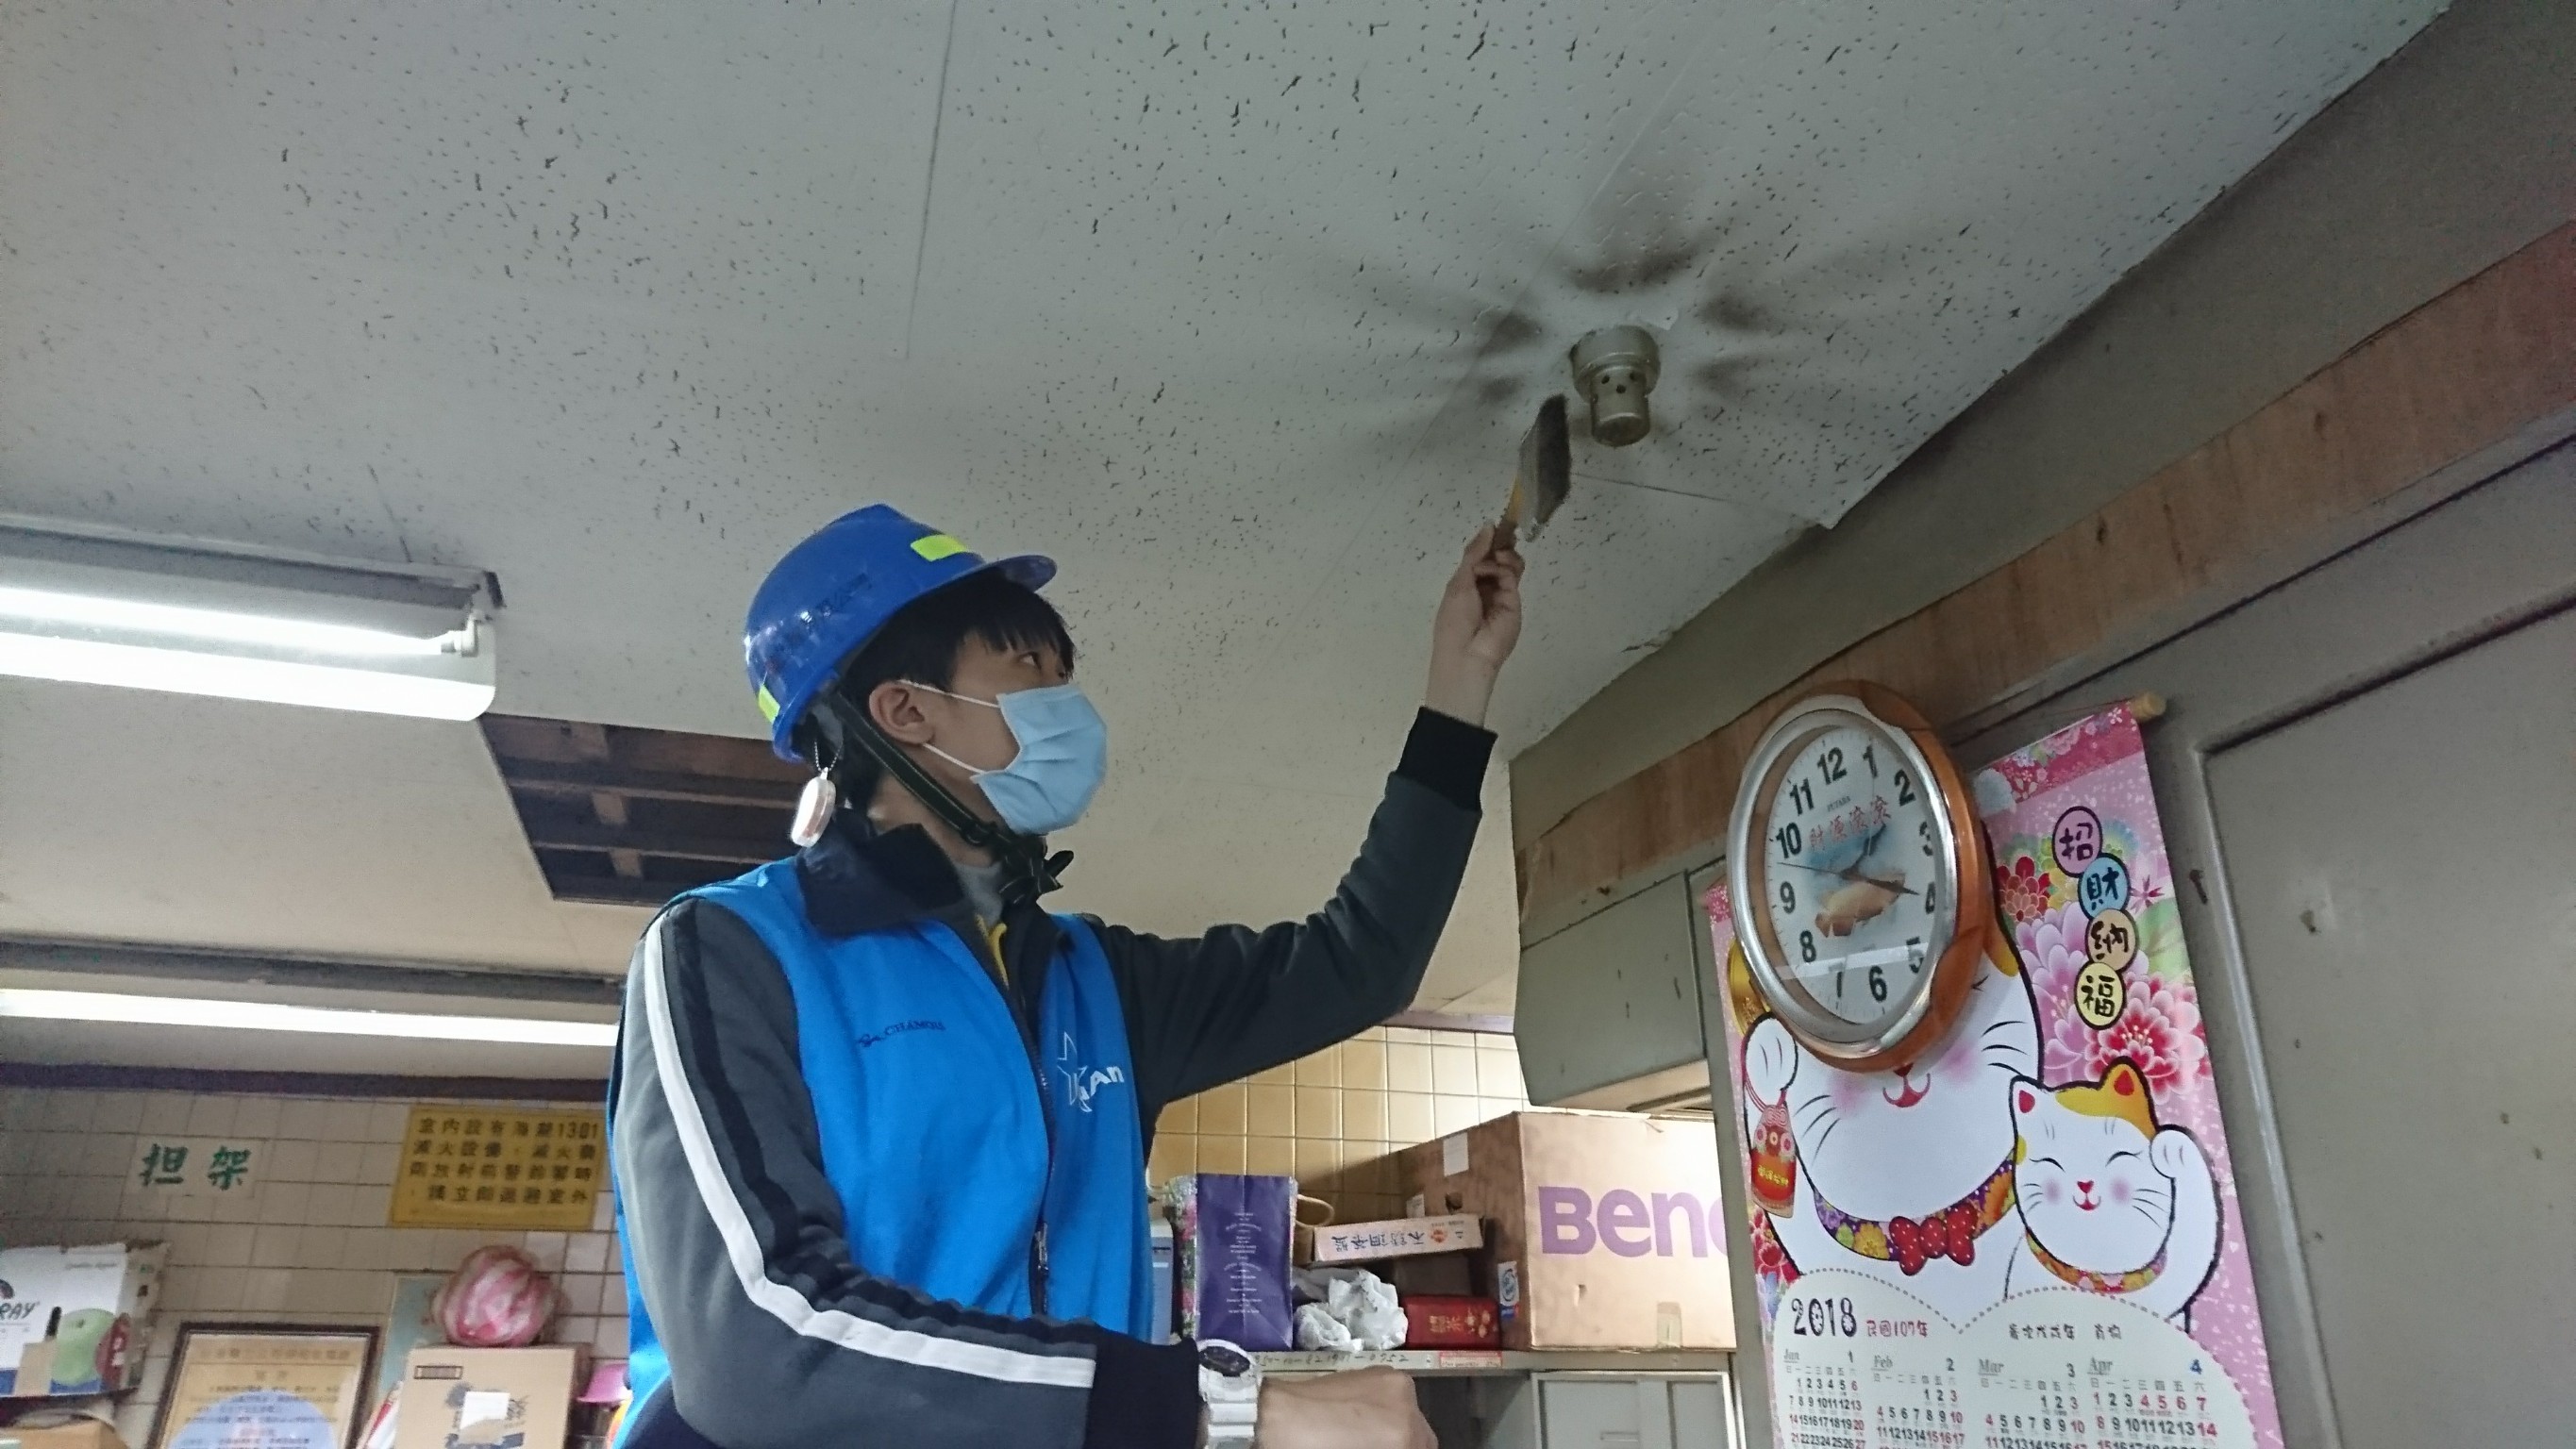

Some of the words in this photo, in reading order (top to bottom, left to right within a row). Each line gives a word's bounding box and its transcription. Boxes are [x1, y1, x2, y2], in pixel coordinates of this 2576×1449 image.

[1816, 746, 1848, 785] 12
[1863, 744, 1878, 779] 1
[1789, 777, 1815, 816] 11
[1894, 769, 1916, 807] 2
[1775, 822, 1802, 858] 10
[1919, 821, 1933, 857] 3
[1780, 881, 1796, 914] 9
[1925, 881, 1936, 914] 4
[2059, 823, 2129, 1018] 招財納福
[1799, 929, 1816, 963] 8
[1906, 936, 1924, 974] 5
[1868, 965, 1887, 1002] 6
[139, 1142, 252, 1191] 担架
[1792, 1297, 1857, 1337] 2018
[1784, 1348, 1799, 1359] Jan
[1848, 1351, 1853, 1363] 1
[1874, 1355, 1893, 1368] Feb
[1947, 1357, 1954, 1371] 2
[1979, 1358, 2004, 1373] Mar
[2066, 1363, 2075, 1377] 3
[2089, 1357, 2113, 1374] Apr
[2190, 1358, 2202, 1374] 4
[1798, 1378, 1800, 1387] 1
[1807, 1378, 1812, 1389] 2
[1817, 1378, 1822, 1389] 3
[1828, 1379, 1833, 1389] 4
[1840, 1379, 1846, 1391] 5
[1851, 1380, 1857, 1391] 6
[1924, 1389, 1930, 1400] 1
[1936, 1390, 1944, 1401] 2
[1950, 1390, 1957, 1402] 3
[1789, 1395, 1794, 1405] 7
[1798, 1396, 1803, 1407] 8
[1809, 1396, 1814, 1407] 9
[1817, 1398, 1827, 1408] 10
[1828, 1398, 1838, 1408] 11
[1839, 1399, 1849, 1409] 12
[1850, 1400, 1862, 1410] 13
[2041, 1395, 2047, 1407] 1
[2055, 1396, 2063, 1408] 2
[2070, 1396, 2078, 1409] 3
[2094, 1391, 2099, 1405] 1
[2108, 1392, 2116, 1406] 2
[2124, 1393, 2133, 1407] 3
[2140, 1394, 2149, 1408] 4
[2158, 1395, 2166, 1409] 5
[2177, 1396, 2186, 1410] 6
[2197, 1397, 2206, 1411] 7
[1790, 1414, 1798, 1424] 14
[1799, 1415, 1808, 1425] 15
[1809, 1416, 1818, 1426] 16
[1819, 1417, 1829, 1426] 17
[1830, 1418, 1840, 1428] 18
[1841, 1419, 1852, 1429] 19
[1853, 1420, 1865, 1430] 20
[1877, 1406, 1883, 1417] 4
[1889, 1407, 1896, 1418] 5
[1901, 1407, 1908, 1419] 6
[1914, 1407, 1919, 1420] 7
[1926, 1409, 1932, 1421] 8
[1939, 1410, 1946, 1423] 9
[1950, 1411, 1963, 1424] 10
[1985, 1414, 1993, 1425] 4
[1999, 1415, 2008, 1427] 5
[2015, 1415, 2022, 1428] 6
[2028, 1416, 2035, 1428] 7
[2043, 1418, 2051, 1431] 8
[2058, 1419, 2066, 1432] 9
[2070, 1420, 2084, 1434] 10
[2097, 1416, 2104, 1429] 8
[2112, 1417, 2120, 1430] 9
[2125, 1418, 2140, 1432] 10
[2141, 1419, 2156, 1433] 11
[2158, 1421, 2176, 1435] 12
[2177, 1422, 2195, 1436] 13
[2197, 1423, 2217, 1437] 14
[1877, 1426, 1887, 1438] 11
[1889, 1426, 1901, 1440] 12
[1902, 1427, 1913, 1440] 13
[1914, 1429, 1926, 1441] 14
[1927, 1430, 1939, 1442] 15
[1939, 1431, 1952, 1444] 16
[1953, 1432, 1965, 1444] 17
